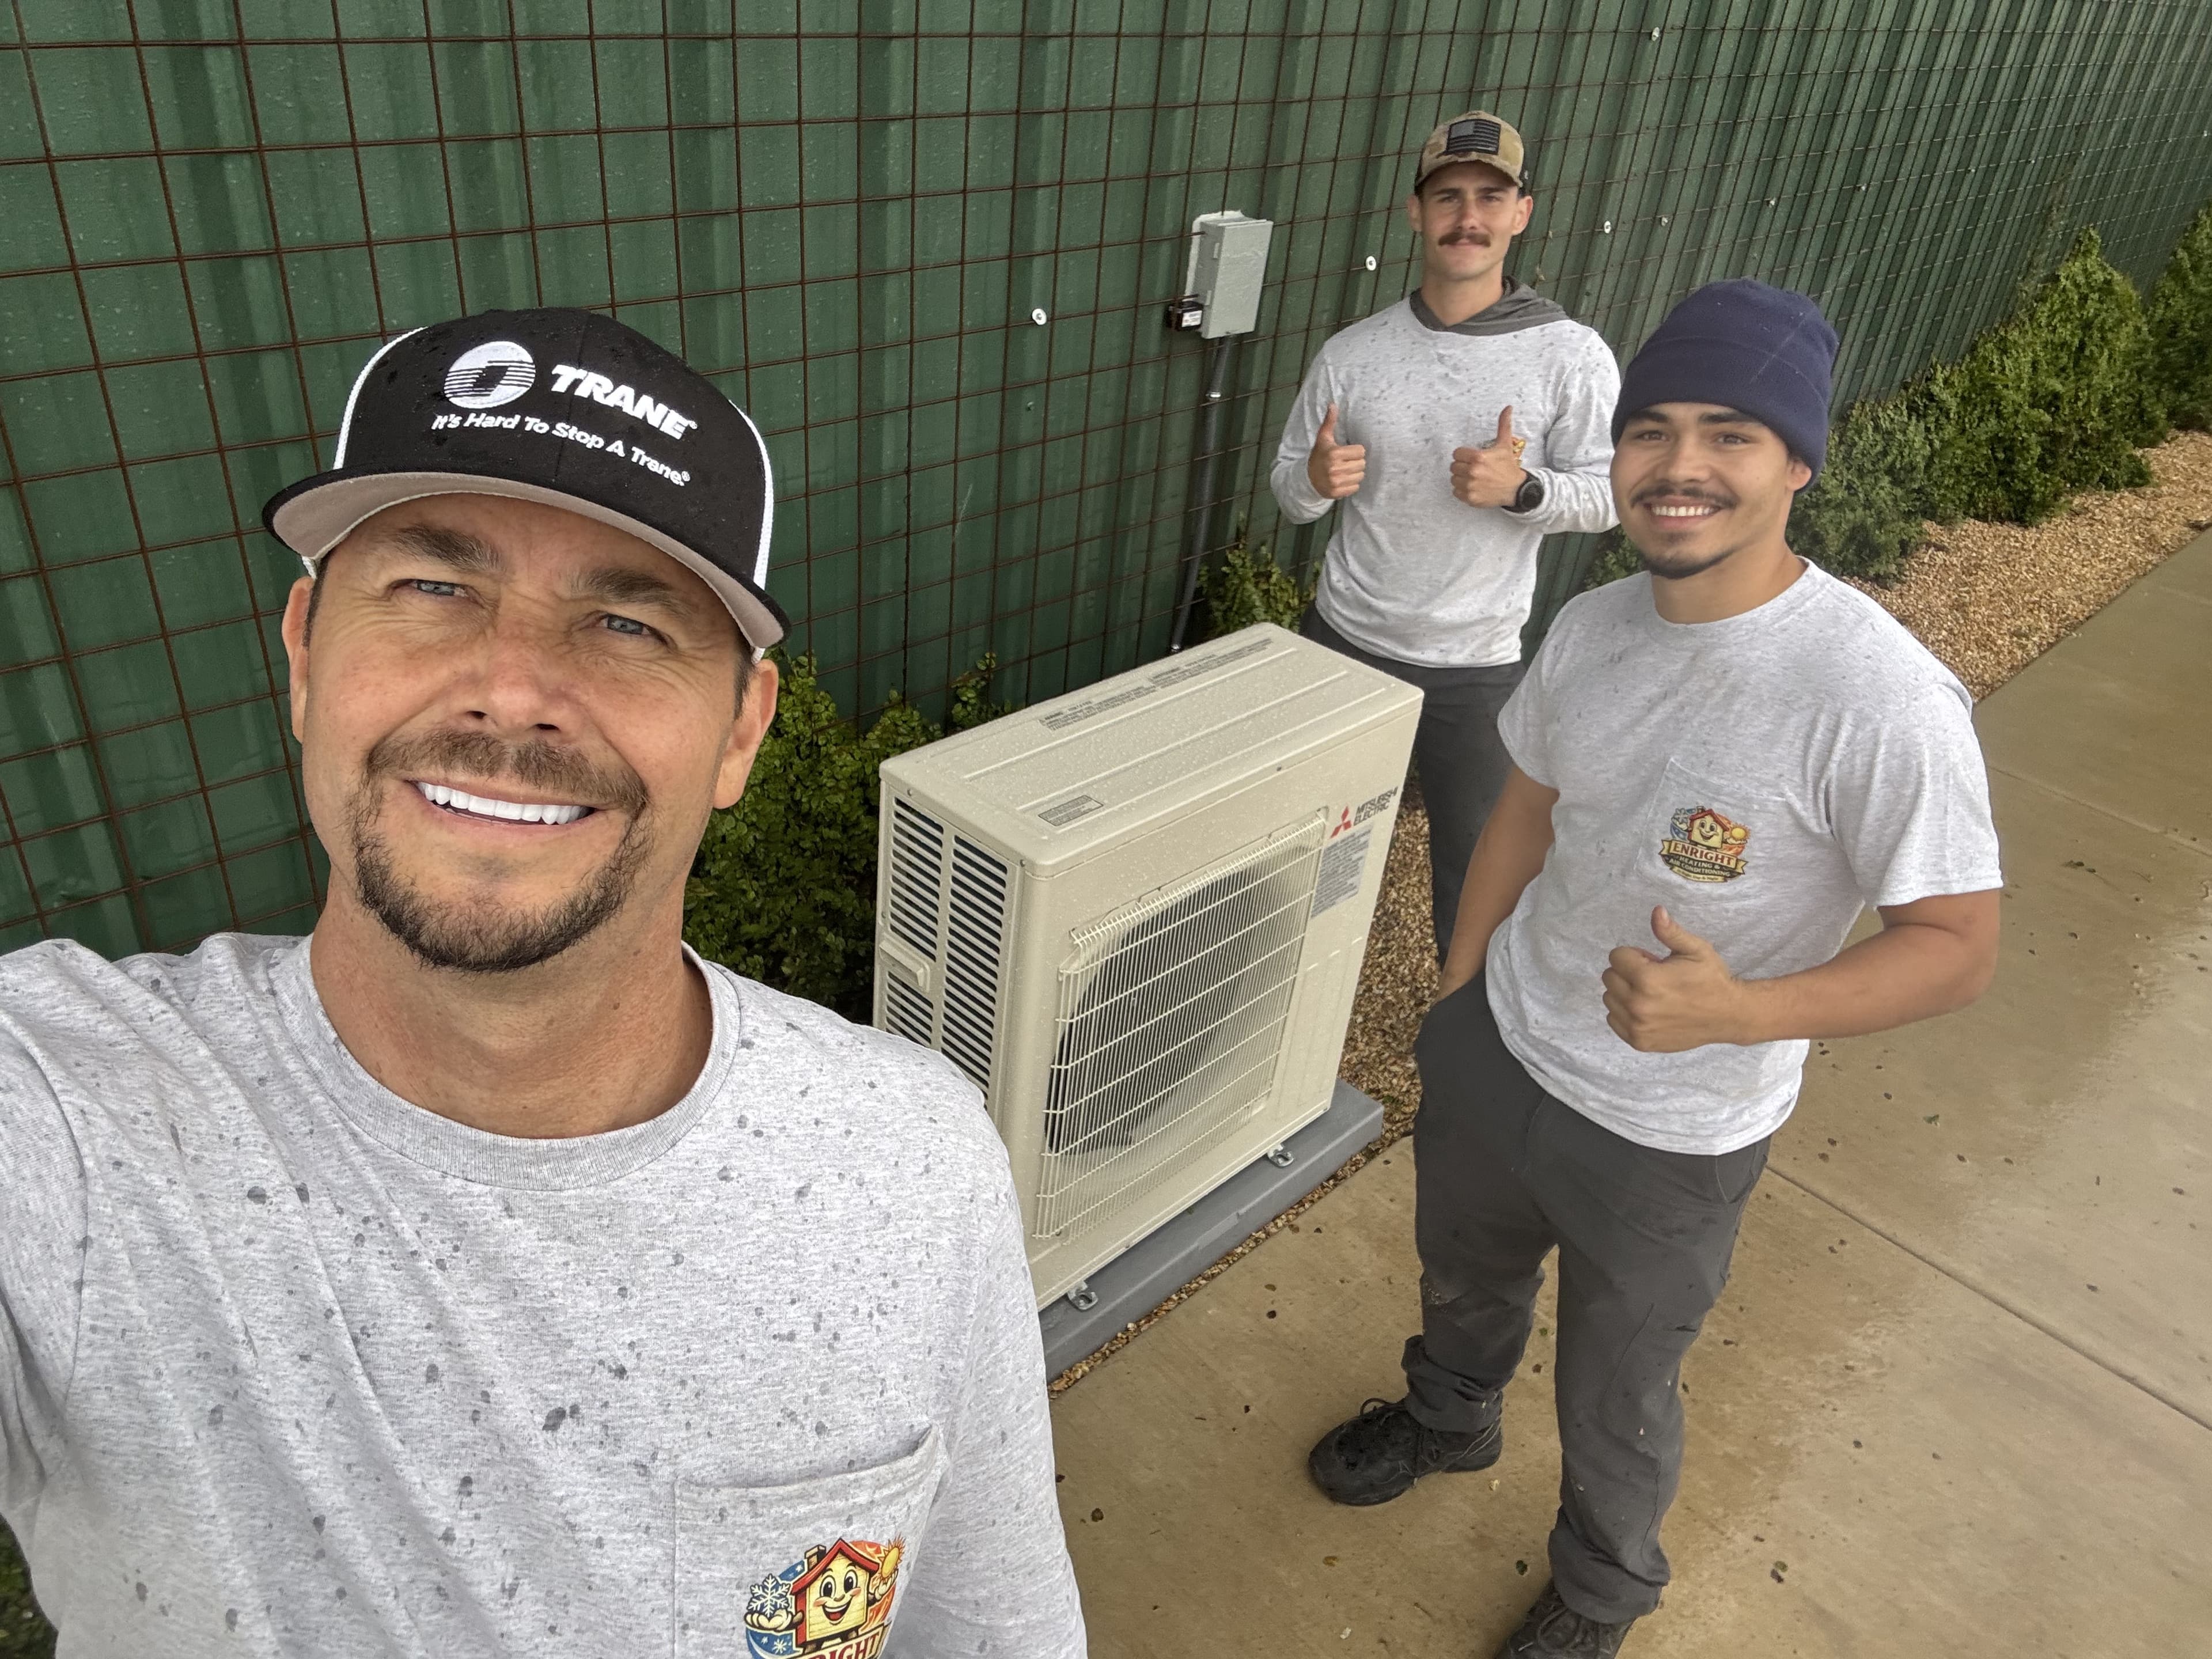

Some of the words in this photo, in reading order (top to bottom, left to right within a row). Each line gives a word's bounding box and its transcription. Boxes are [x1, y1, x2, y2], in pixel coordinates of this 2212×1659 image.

[431, 414, 461, 430] It's
[463, 413, 521, 429] Hard
[524, 416, 550, 434] To
[552, 422, 605, 449] Stop
[605, 440, 626, 457] A
[1673, 842, 1732, 865] ENRIGHT
[1679, 856, 1713, 868] HEATING
[1681, 863, 1731, 876] CONDITIONING
[808, 1631, 880, 1659] GHT
